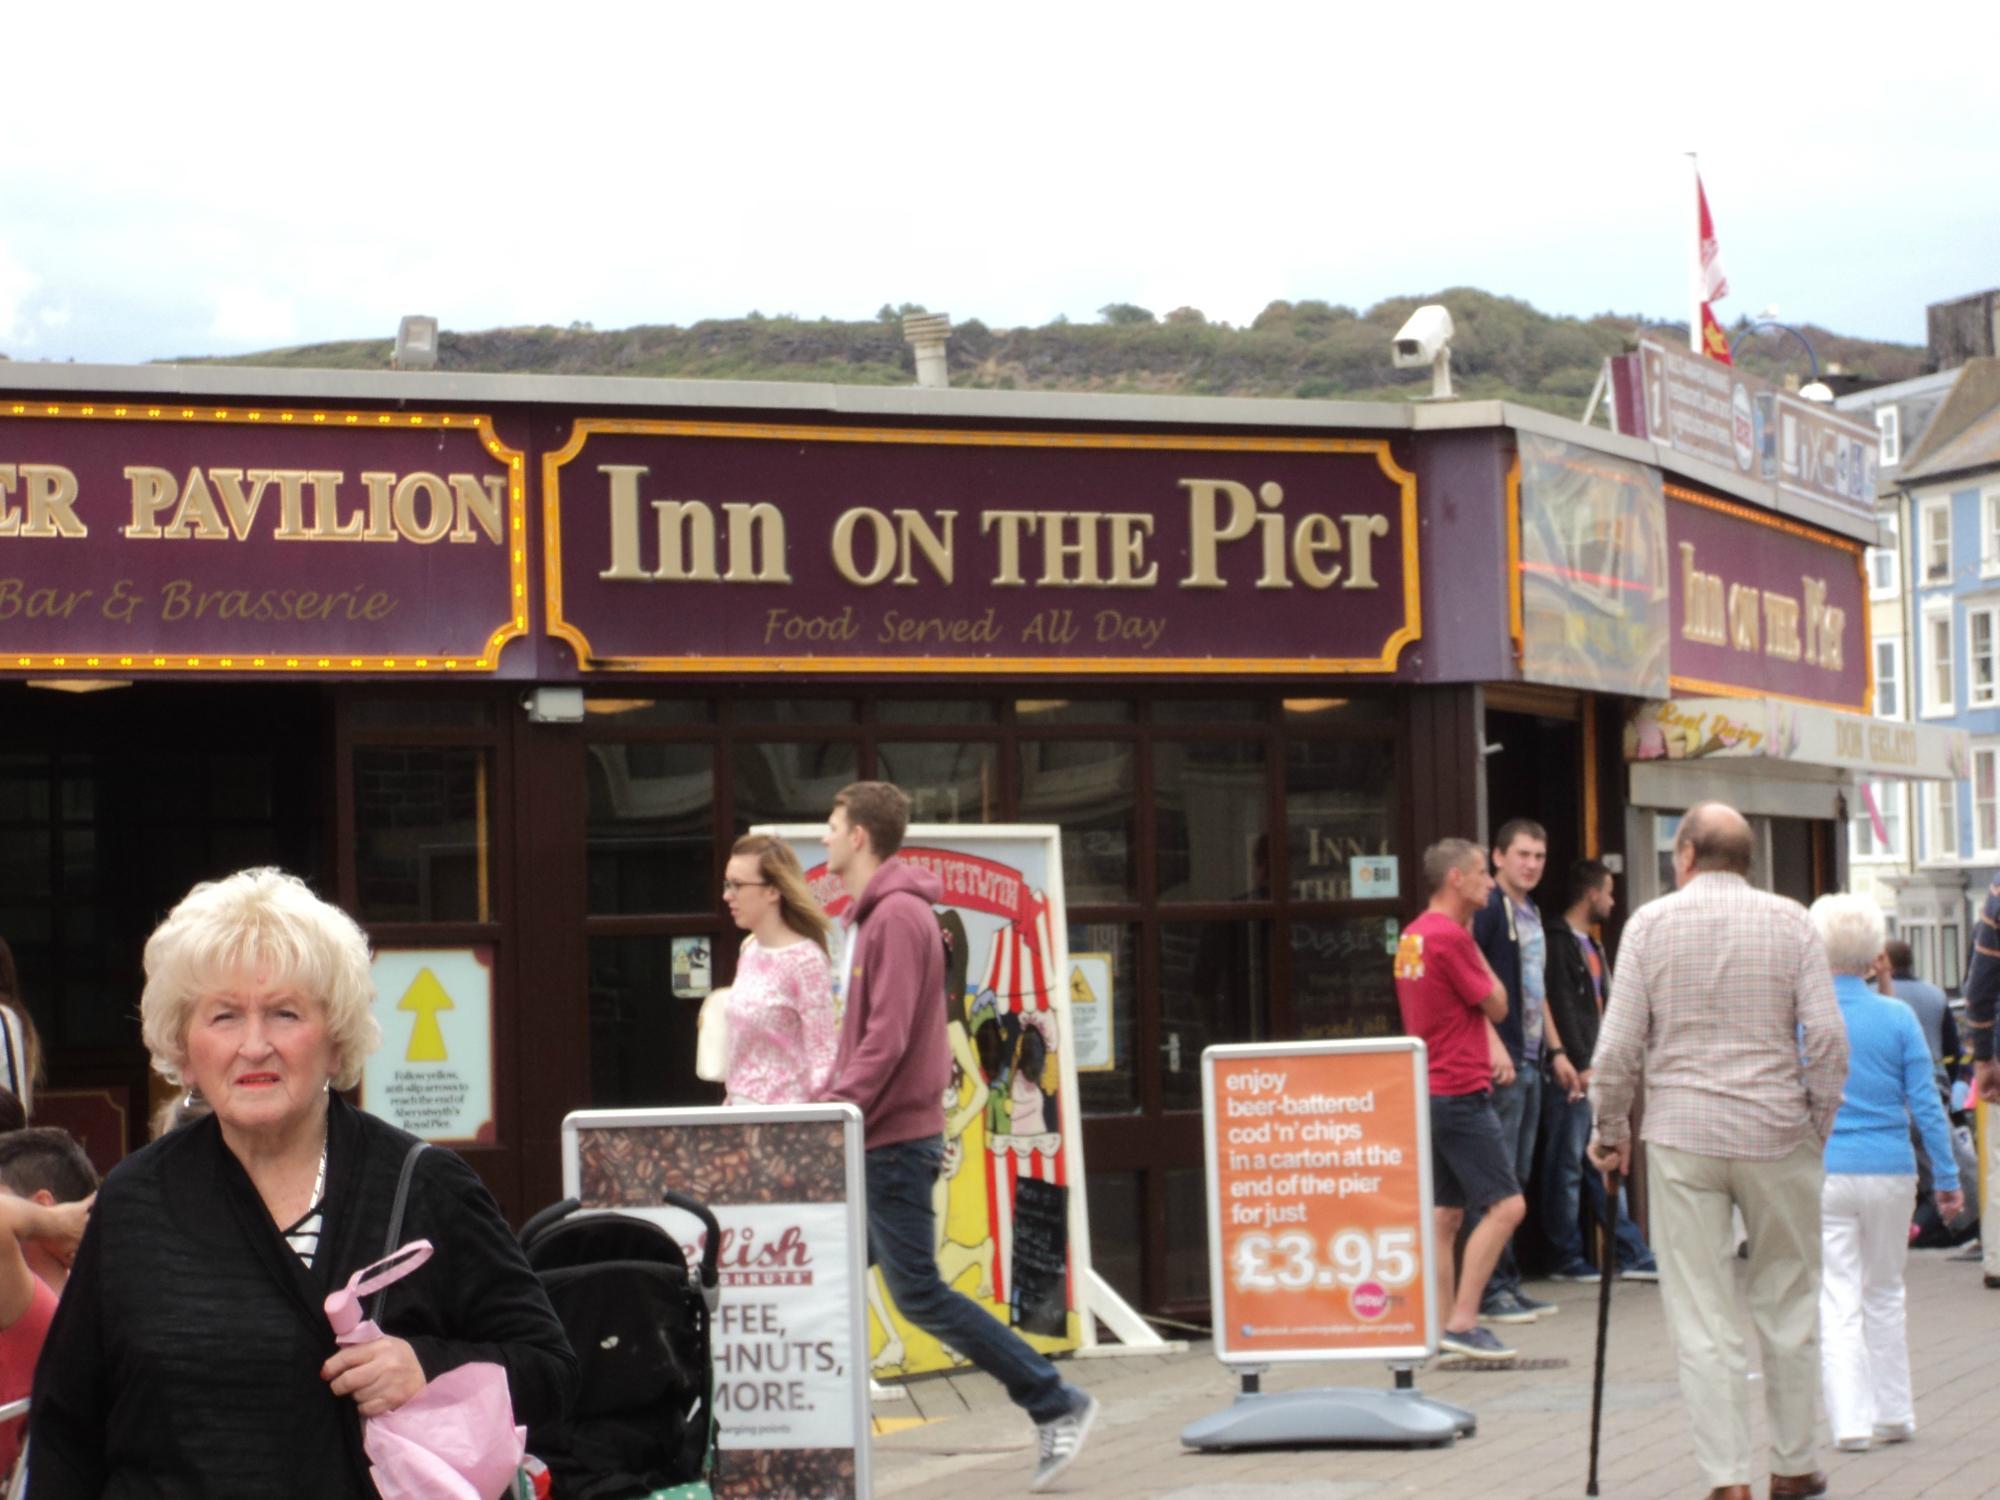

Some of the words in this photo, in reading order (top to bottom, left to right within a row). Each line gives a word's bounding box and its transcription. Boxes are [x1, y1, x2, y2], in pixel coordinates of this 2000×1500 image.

[0, 464, 88, 539] ER
[124, 466, 505, 544] PAVILION
[598, 464, 791, 584] Inn
[831, 506, 959, 587] ON
[981, 509, 1159, 588] THE
[1178, 478, 1390, 590] Pier
[0, 577, 93, 621] Bar
[101, 578, 144, 624] &
[161, 577, 397, 621] Brasserie
[763, 608, 859, 646] Food
[877, 608, 1001, 645] Served
[1022, 610, 1080, 645] All
[1095, 611, 1167, 650] Day
[1763, 590, 1801, 663] THE
[1226, 1070, 1287, 1094] enjoy
[1227, 1092, 1374, 1117] beer-battered
[1228, 1121, 1270, 1144] cod
[1301, 1121, 1363, 1145] chips
[1229, 1150, 1249, 1170] in
[1253, 1154, 1267, 1169] a
[1269, 1150, 1340, 1169] carton
[1342, 1149, 1364, 1167] at
[1364, 1145, 1403, 1166] the
[1230, 1176, 1273, 1198] end
[1276, 1175, 1299, 1196] of
[1299, 1174, 1337, 1195] the
[1338, 1174, 1381, 1198] pier
[1231, 1203, 1264, 1225] for
[1264, 1202, 1307, 1227] just
[1236, 1231, 1417, 1288] £3.95
[711, 1304, 786, 1337] FEE,
[714, 1341, 843, 1376] HNUTS,
